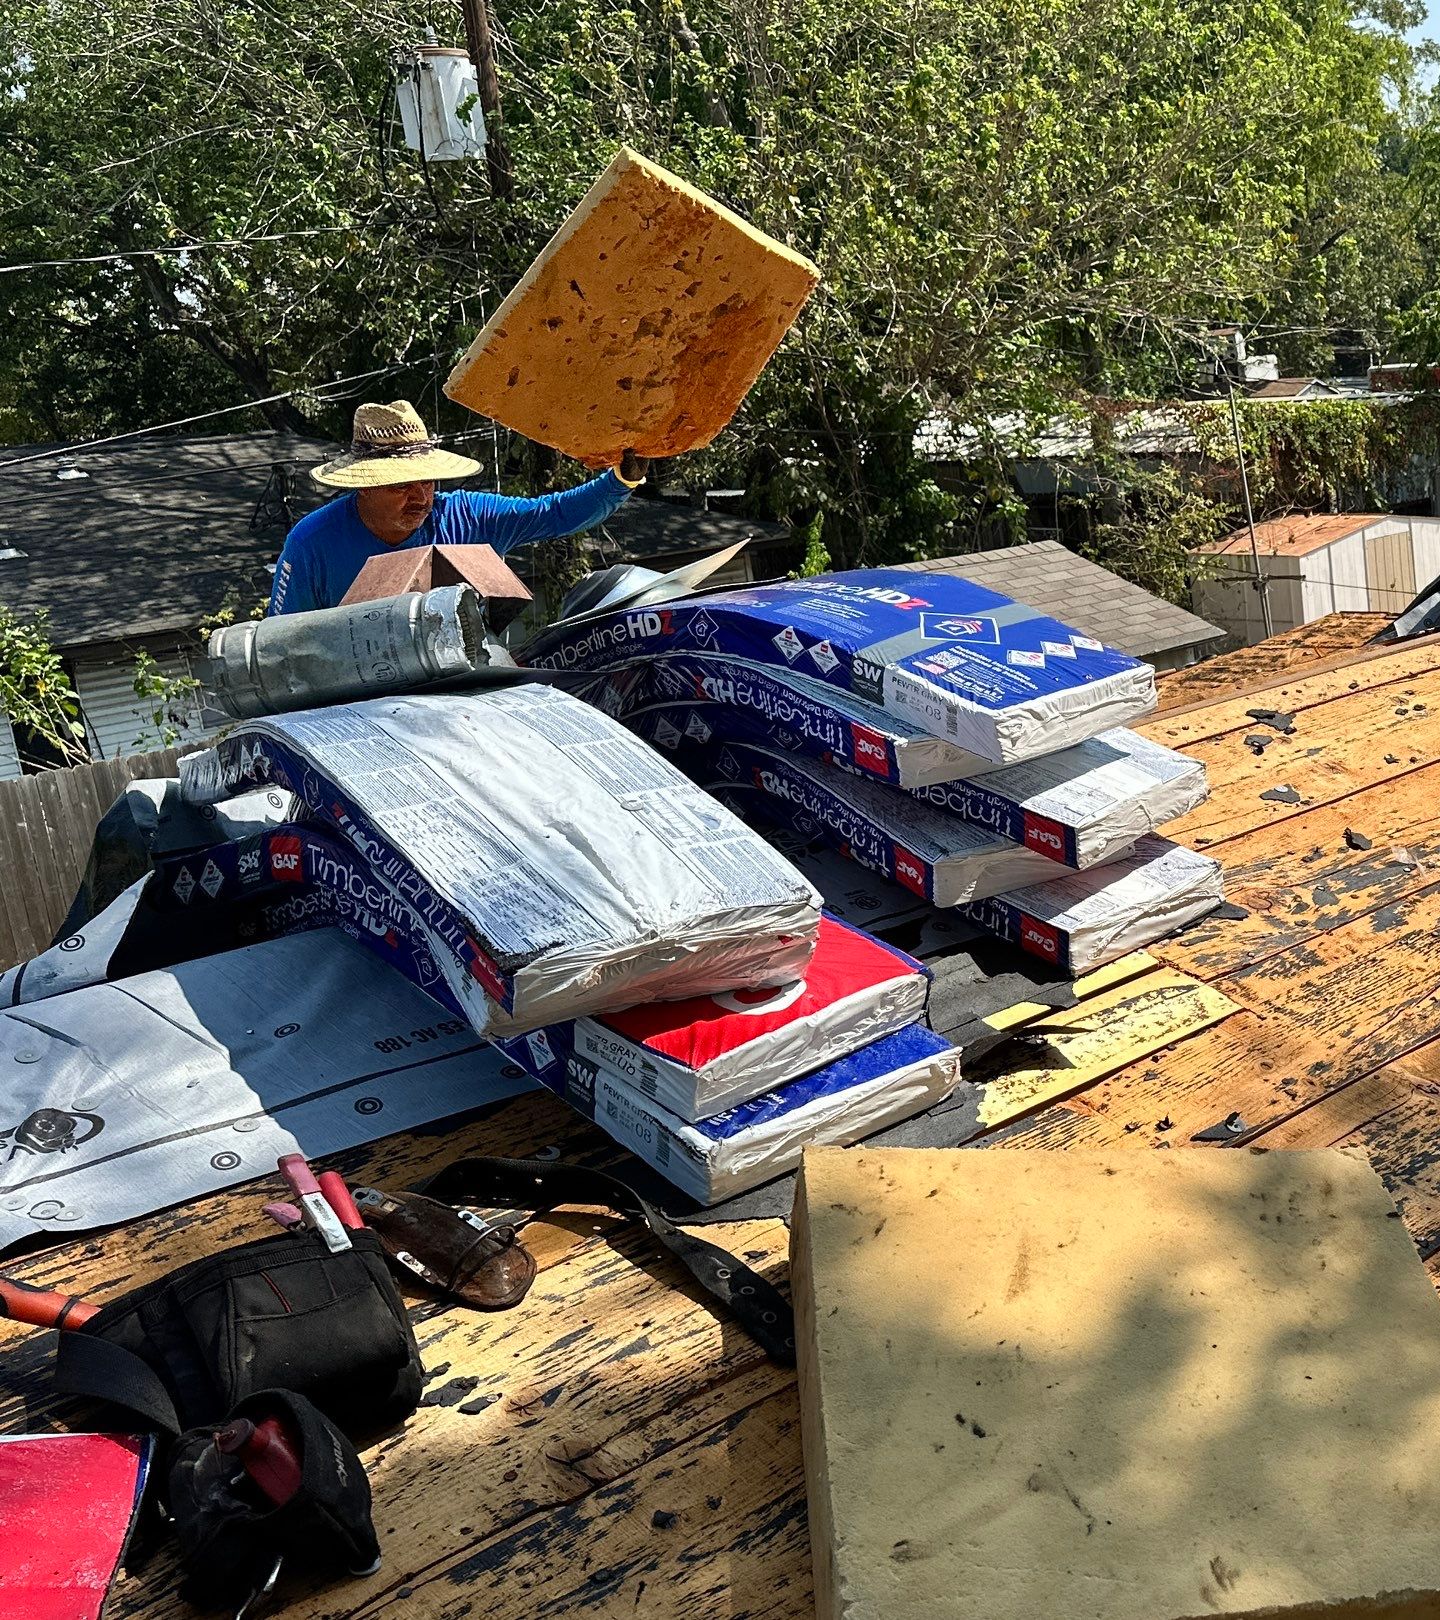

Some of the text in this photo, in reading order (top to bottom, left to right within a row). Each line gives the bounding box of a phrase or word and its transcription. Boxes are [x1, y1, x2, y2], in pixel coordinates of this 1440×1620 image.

[852, 659, 883, 684] SW
[1028, 827, 1063, 851] GAF
[272, 852, 300, 870] GAF
[373, 1035, 413, 1054] 188
[410, 1026, 440, 1044] AC
[609, 1041, 638, 1060] GRAY
[566, 1057, 596, 1089] SW
[603, 1082, 631, 1108] PEWTR
[634, 1122, 653, 1144] 08
